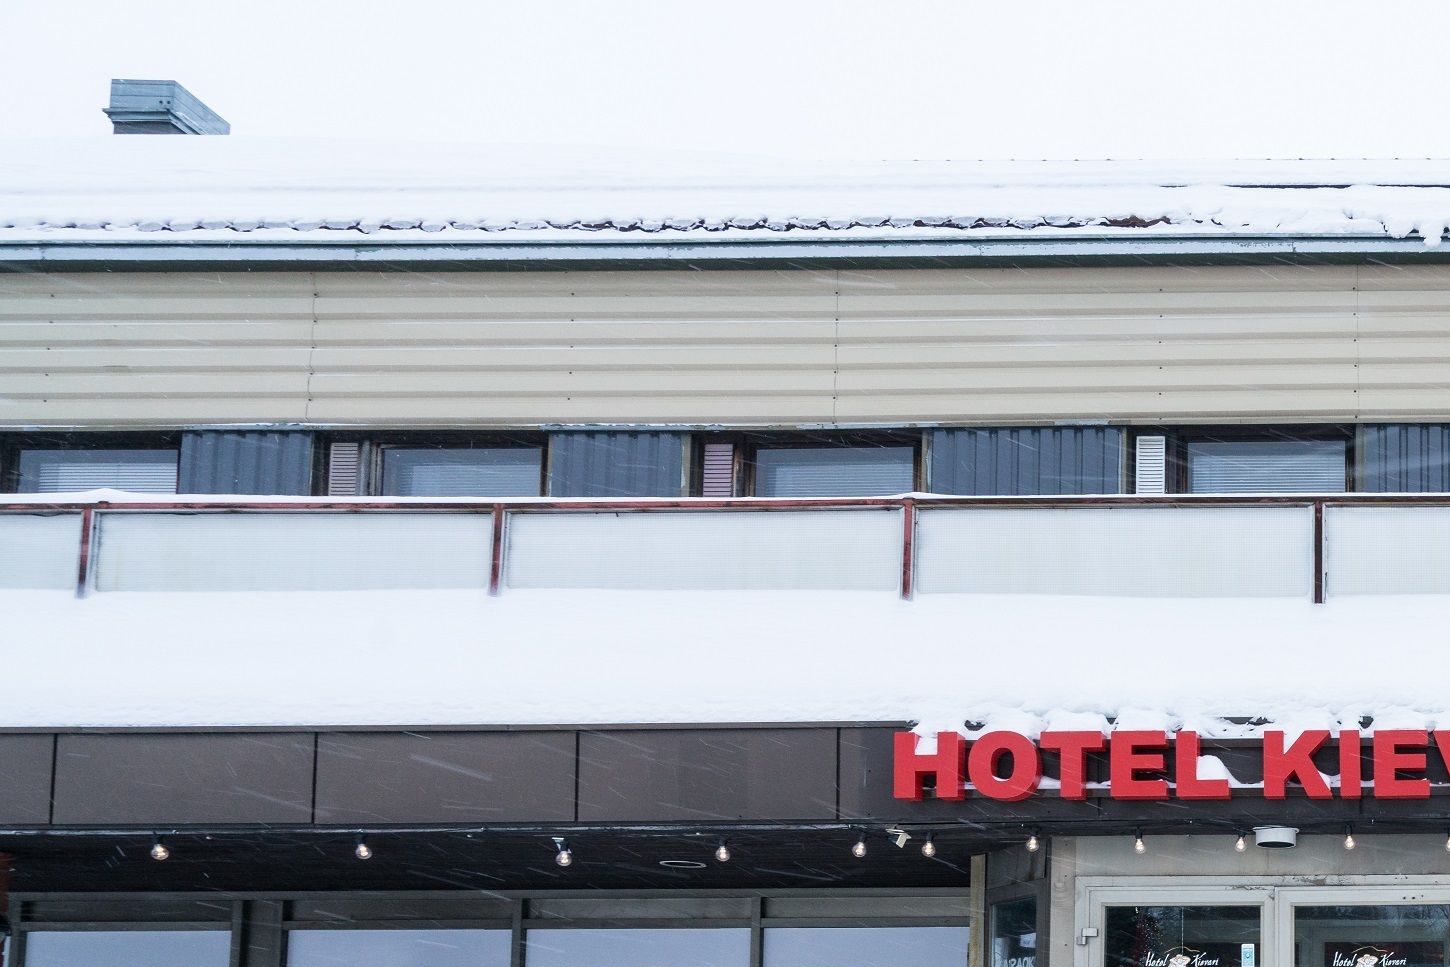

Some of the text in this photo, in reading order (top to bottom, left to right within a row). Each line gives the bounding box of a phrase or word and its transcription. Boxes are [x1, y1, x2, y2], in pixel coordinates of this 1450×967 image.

[894, 730, 1232, 800] HOTEL
[1145, 951, 1219, 967] Hotel Kievari
[1332, 951, 1407, 967] Hotel Kievari
